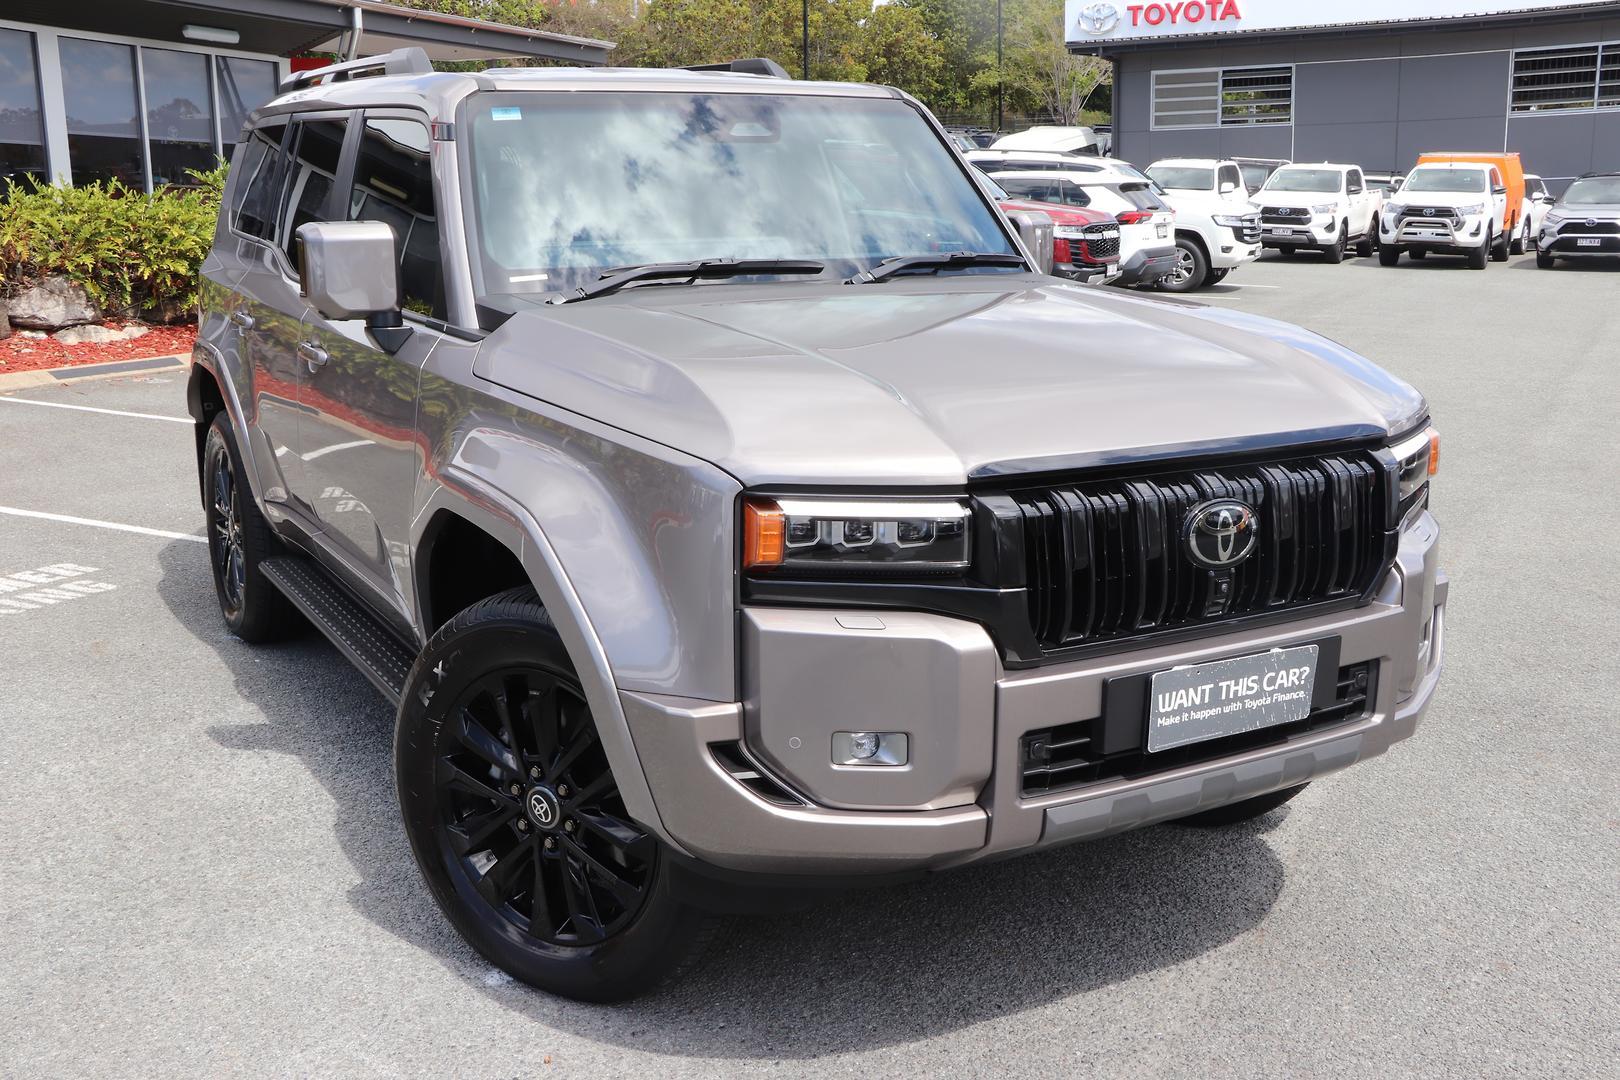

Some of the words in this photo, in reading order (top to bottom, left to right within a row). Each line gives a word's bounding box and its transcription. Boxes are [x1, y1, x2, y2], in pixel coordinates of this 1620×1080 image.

[1127, 0, 1241, 27] TOYOTA
[1158, 684, 1214, 713] WANT
[1219, 675, 1259, 700] THIS
[1262, 666, 1311, 691] CAR?
[1157, 715, 1181, 728] Make
[1182, 712, 1189, 722] it
[1190, 706, 1222, 721] happen
[1223, 702, 1243, 713] with
[1244, 695, 1272, 709] Toyota
